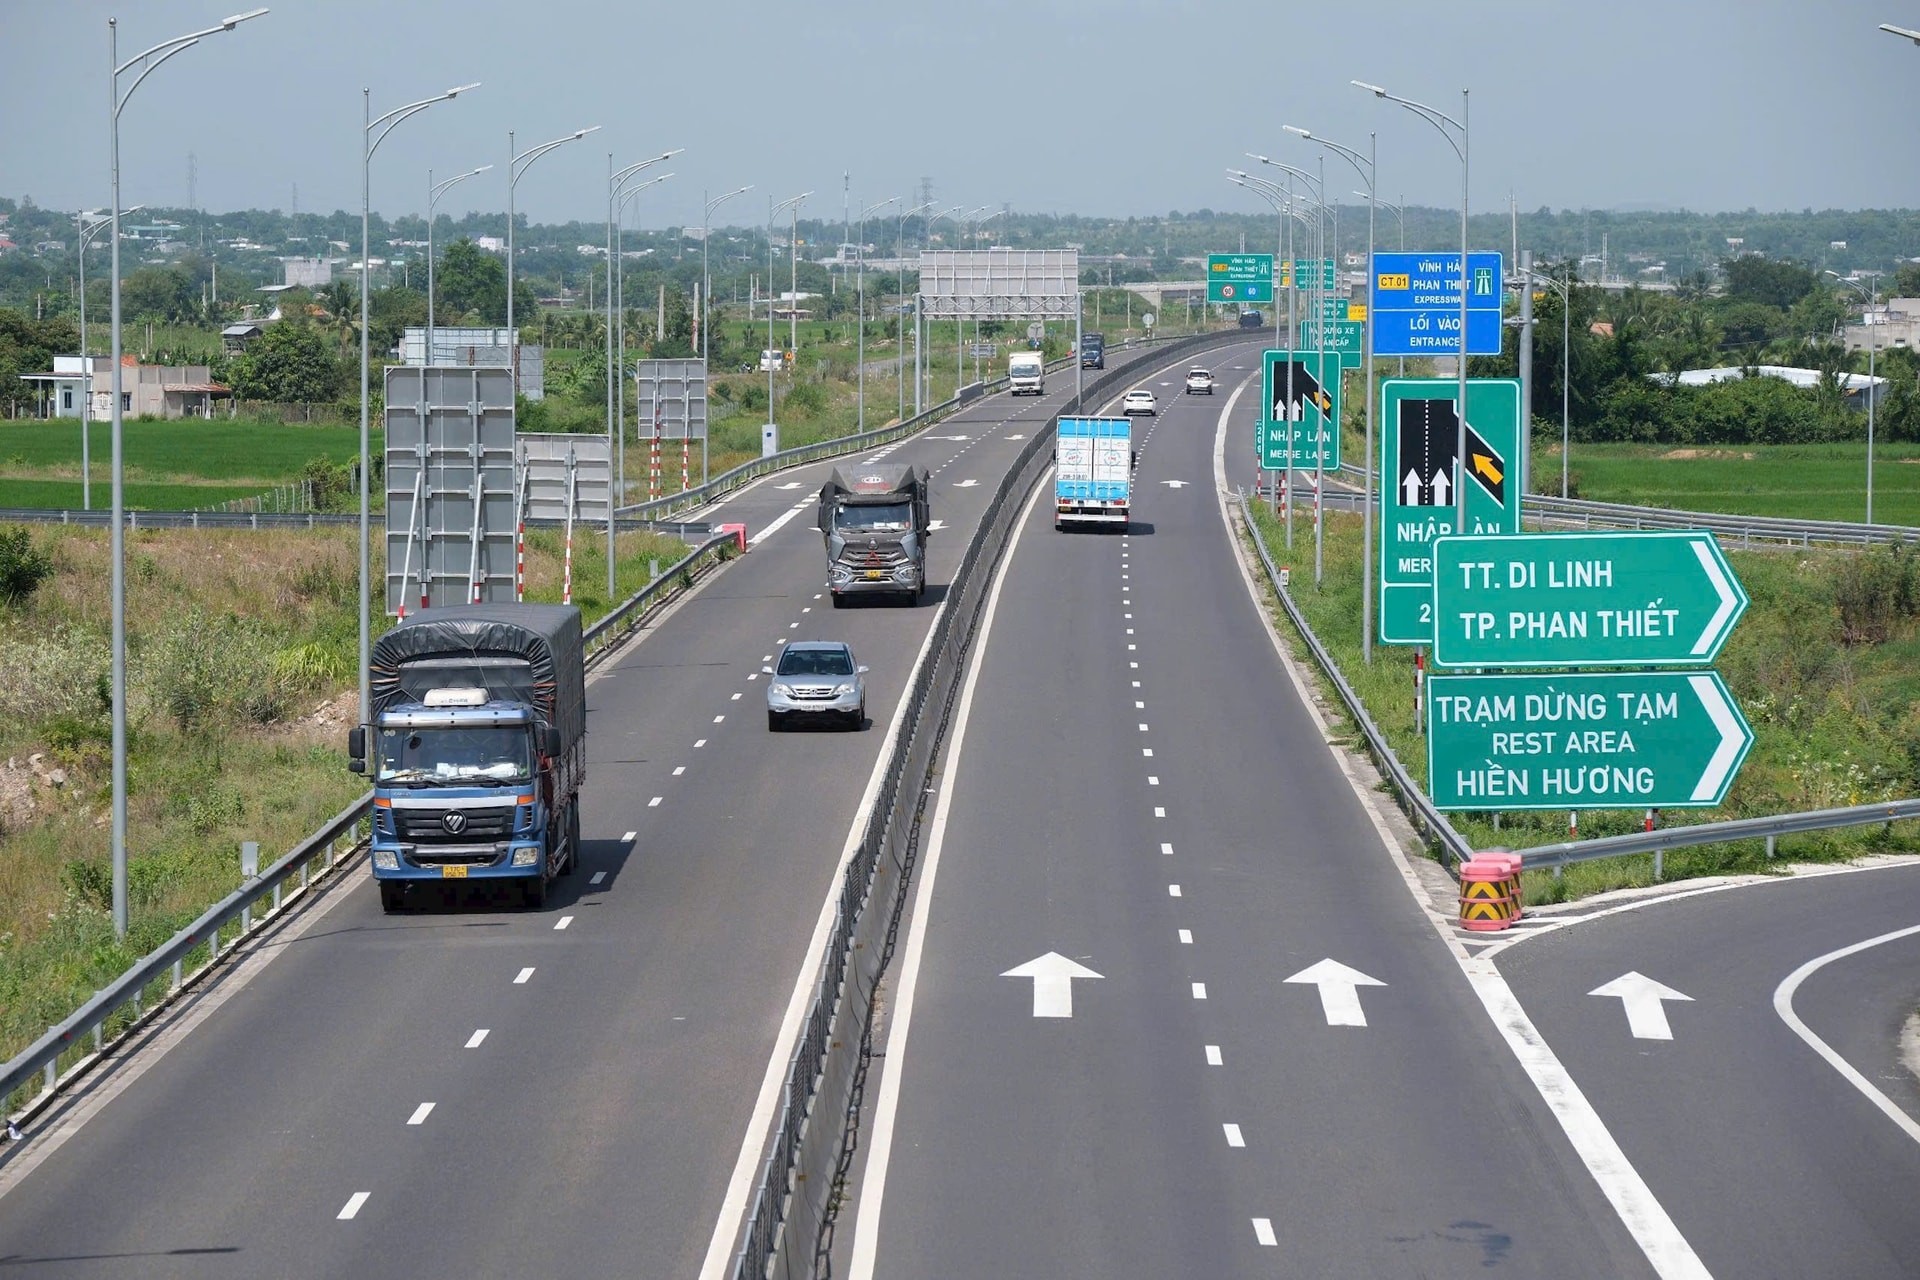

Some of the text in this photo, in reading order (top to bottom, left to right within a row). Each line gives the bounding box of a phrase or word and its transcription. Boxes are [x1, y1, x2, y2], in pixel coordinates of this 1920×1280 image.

[1418, 258, 1462, 273] VĨNH HẢ
[1380, 276, 1407, 287] CT.01
[1413, 279, 1472, 290] PHAN THIT
[1414, 295, 1461, 304] EXPRESSWA
[1410, 312, 1461, 331] LỐI VÀO
[1345, 327, 1355, 335] XE
[1409, 337, 1460, 347] ENTRANCE
[1305, 450, 1331, 460] LAE
[1459, 560, 1612, 589] TT. DI LINH
[1459, 598, 1680, 639] TP. PHAN THIẾT
[1436, 686, 1678, 728] TRẠM DỪNG TẠM
[1492, 730, 1636, 755] REST AREA
[1457, 758, 1655, 796] HIỀN HƯƠNG
